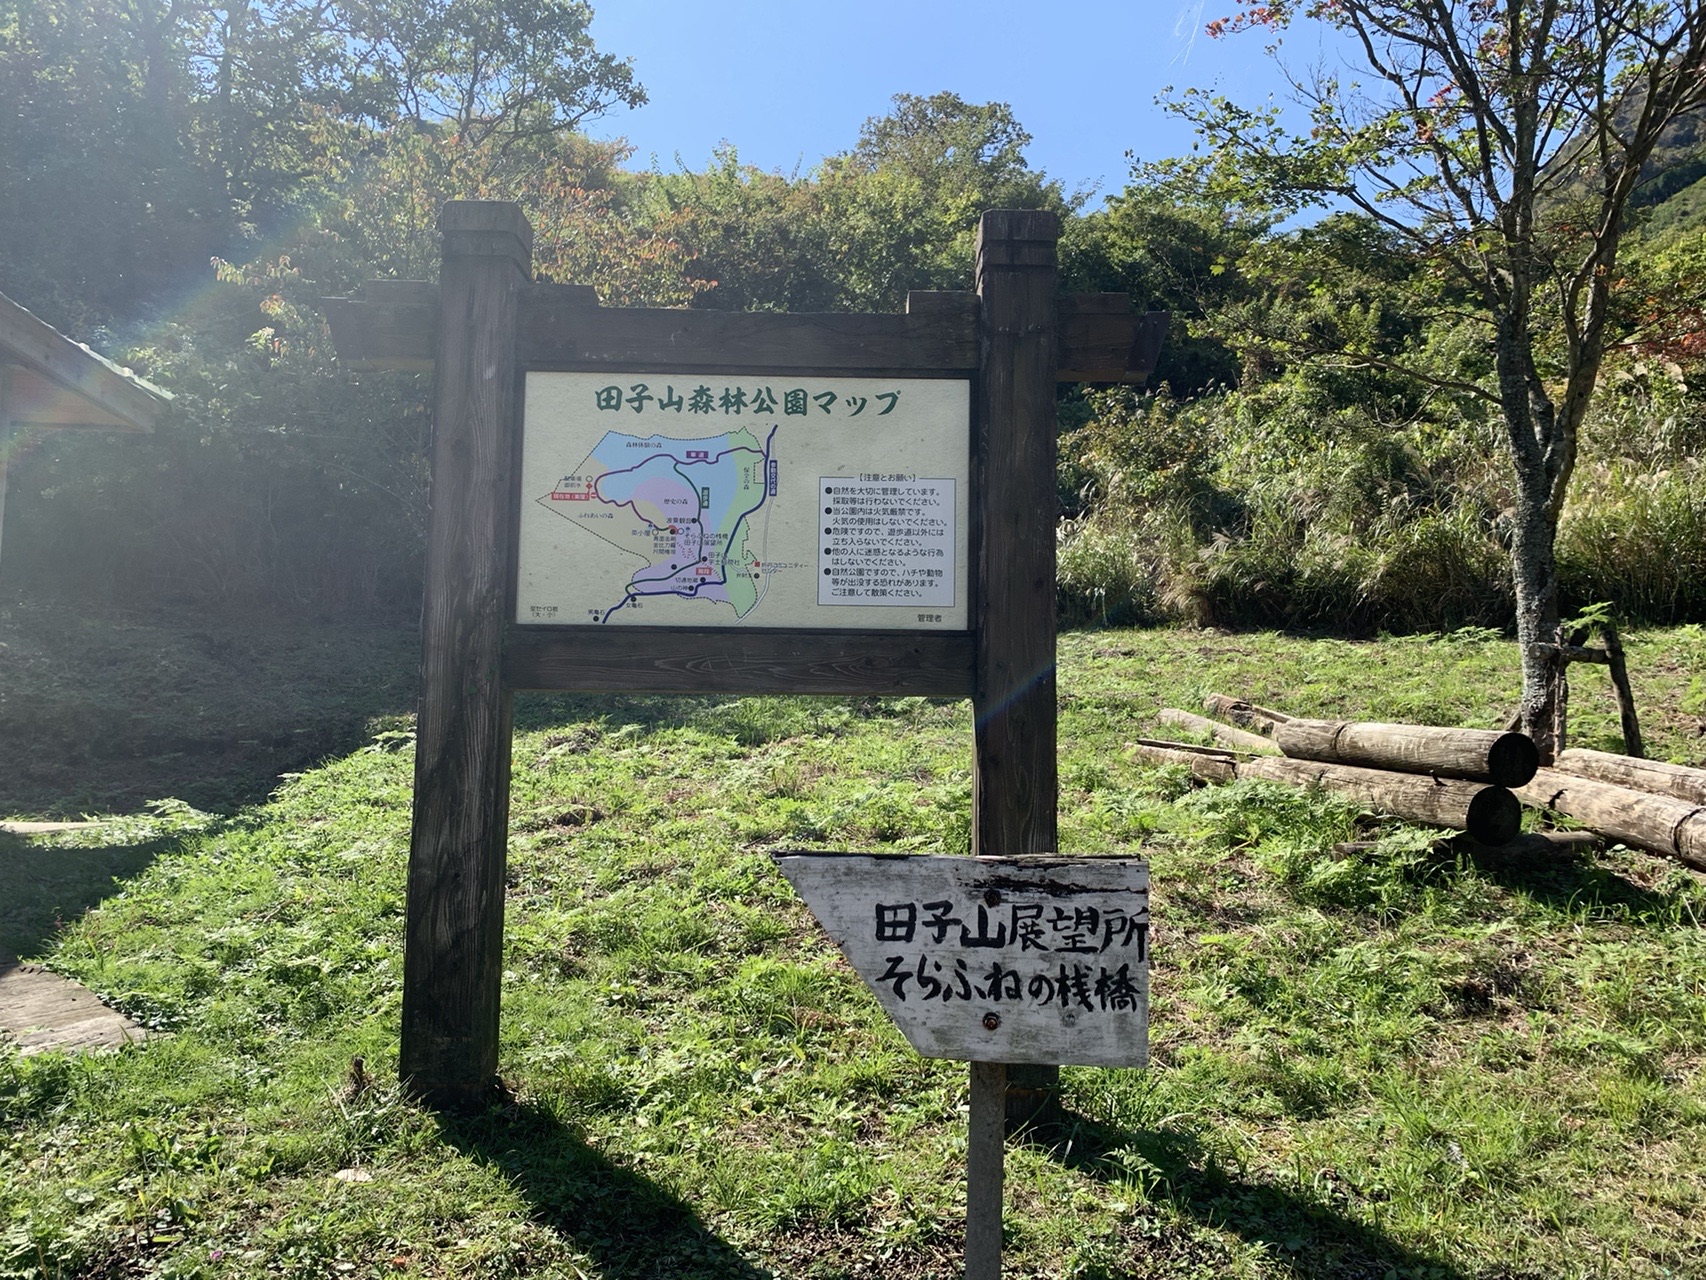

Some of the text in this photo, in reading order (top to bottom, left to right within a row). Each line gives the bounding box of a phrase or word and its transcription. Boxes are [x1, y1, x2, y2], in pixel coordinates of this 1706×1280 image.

[595, 384, 902, 418] 田子山森林公園マップ
[833, 487, 940, 496] 自然を大切に管理しています。
[832, 497, 940, 506] 採取等は行わないでください。
[832, 507, 926, 516] 当公園内は火気厳禁です。
[832, 517, 948, 526] 火気の使用はしないでください。
[832, 527, 944, 536] 危険ですので、遊歩道以外には
[832, 538, 922, 546] 立ち入らないでください。
[832, 548, 944, 557] 他の人に迷惑となるような行為
[832, 558, 906, 566] はしないでください。
[832, 568, 943, 577] 自然公園ですので、ハチや動物
[832, 578, 938, 587] 等が出没する恐れがあります。
[831, 588, 922, 597] ご注意して散策ください。
[918, 614, 942, 622] 管理者
[875, 900, 1148, 962] 田子山展望所
[875, 953, 1142, 1012] そらふねの桟橋
